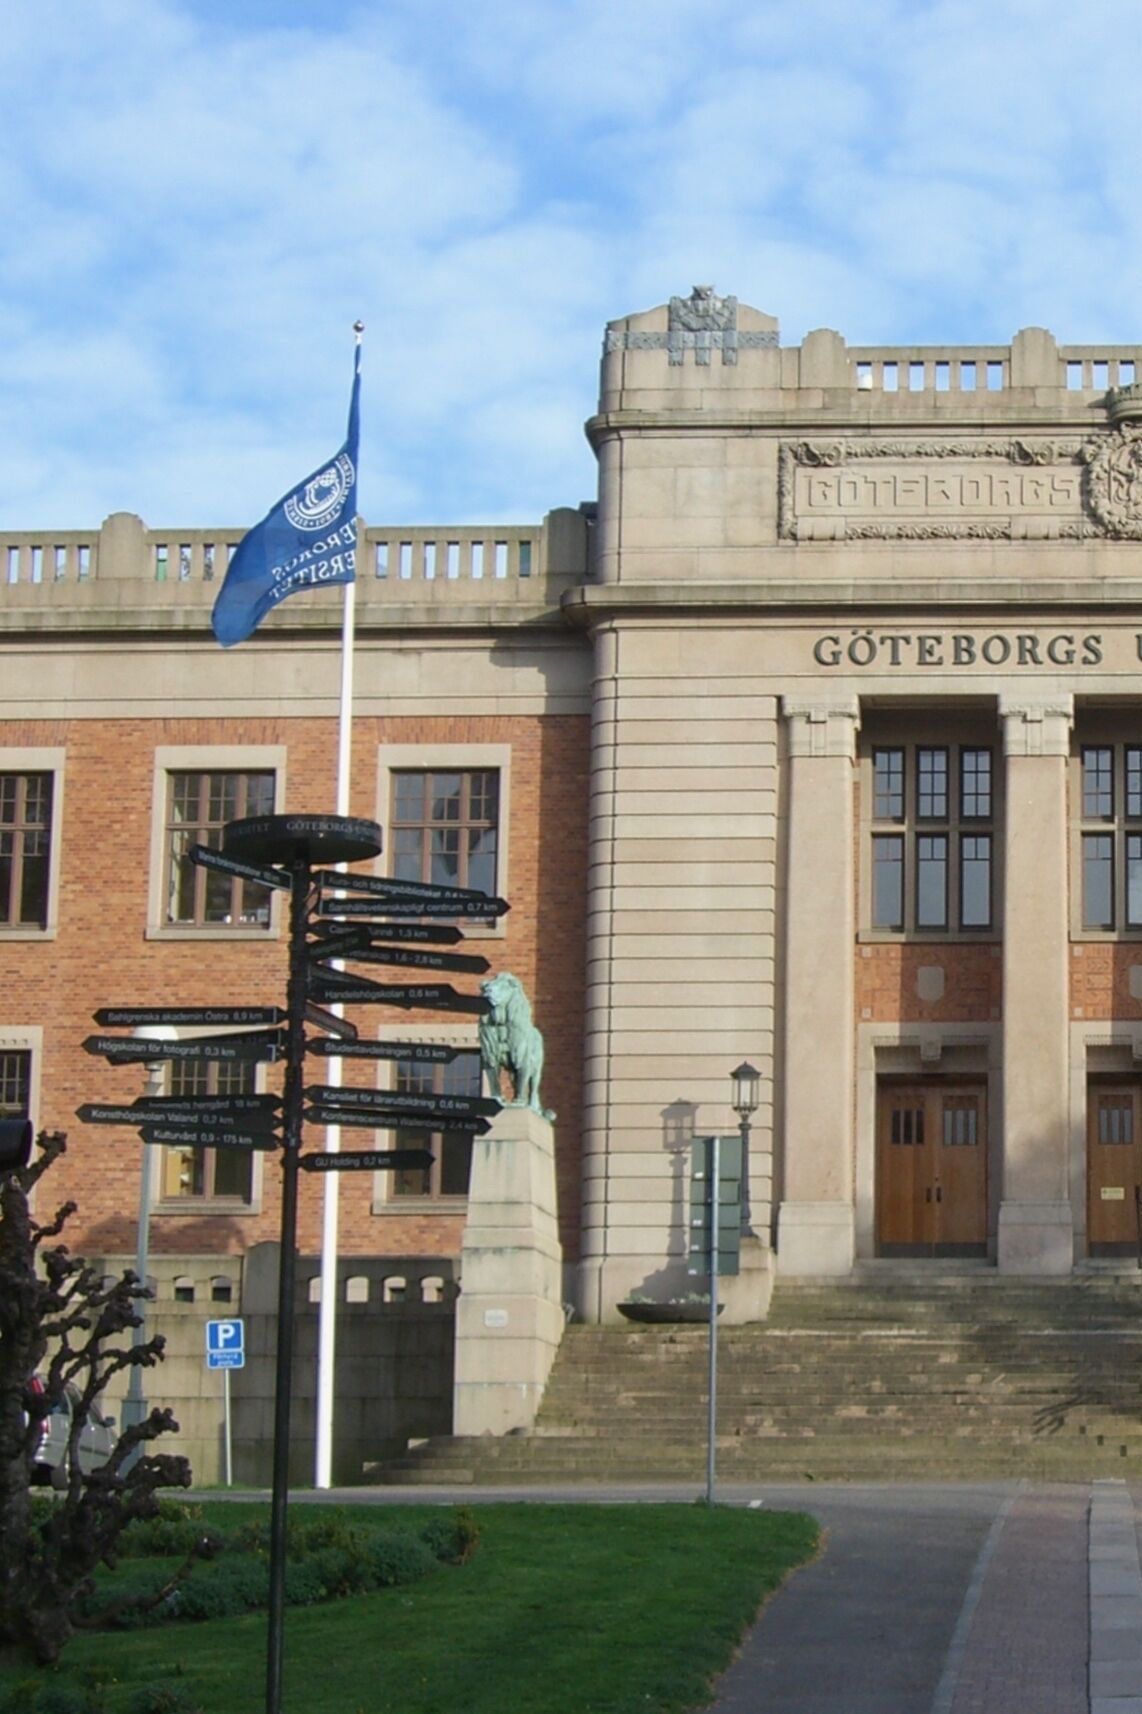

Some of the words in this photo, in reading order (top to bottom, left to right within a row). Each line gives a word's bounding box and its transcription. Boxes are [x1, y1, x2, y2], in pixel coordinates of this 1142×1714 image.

[813, 630, 1103, 666] GÖTEBORGS
[286, 820, 353, 833] GÖTEBORGS
[427, 903, 462, 912] centrum
[467, 903, 481, 913] 0,7
[484, 903, 498, 912] km
[414, 929, 428, 938] km
[429, 955, 442, 965] km
[324, 990, 405, 1001] Handelshögskolan
[425, 989, 439, 997] km
[108, 1012, 160, 1023] Sahlgrenska
[162, 1012, 203, 1021] akademin
[204, 1011, 229, 1021] Östra
[249, 1012, 263, 1020] km
[98, 1041, 146, 1053] Högskolan
[148, 1043, 161, 1053] för
[163, 1044, 201, 1056] fotografi
[221, 1047, 236, 1057] km
[325, 1042, 412, 1058] Studentavdelningen
[431, 1049, 447, 1059] km
[246, 1099, 260, 1108] km
[322, 1091, 358, 1102] Kansliet
[360, 1093, 371, 1103] för
[374, 1094, 436, 1110] lärarutbildning
[455, 1100, 470, 1110] km
[91, 1110, 165, 1122] Konsthögskolan
[167, 1112, 198, 1123] Valand
[219, 1116, 234, 1125] km
[321, 1111, 397, 1125] Konferenscentrum
[464, 1120, 478, 1130] km
[153, 1129, 198, 1142] Kulturvård
[223, 1133, 237, 1143] 175
[239, 1134, 252, 1145] km
[330, 1156, 360, 1167] Holding
[378, 1156, 390, 1165] km
[218, 1324, 235, 1348] P
